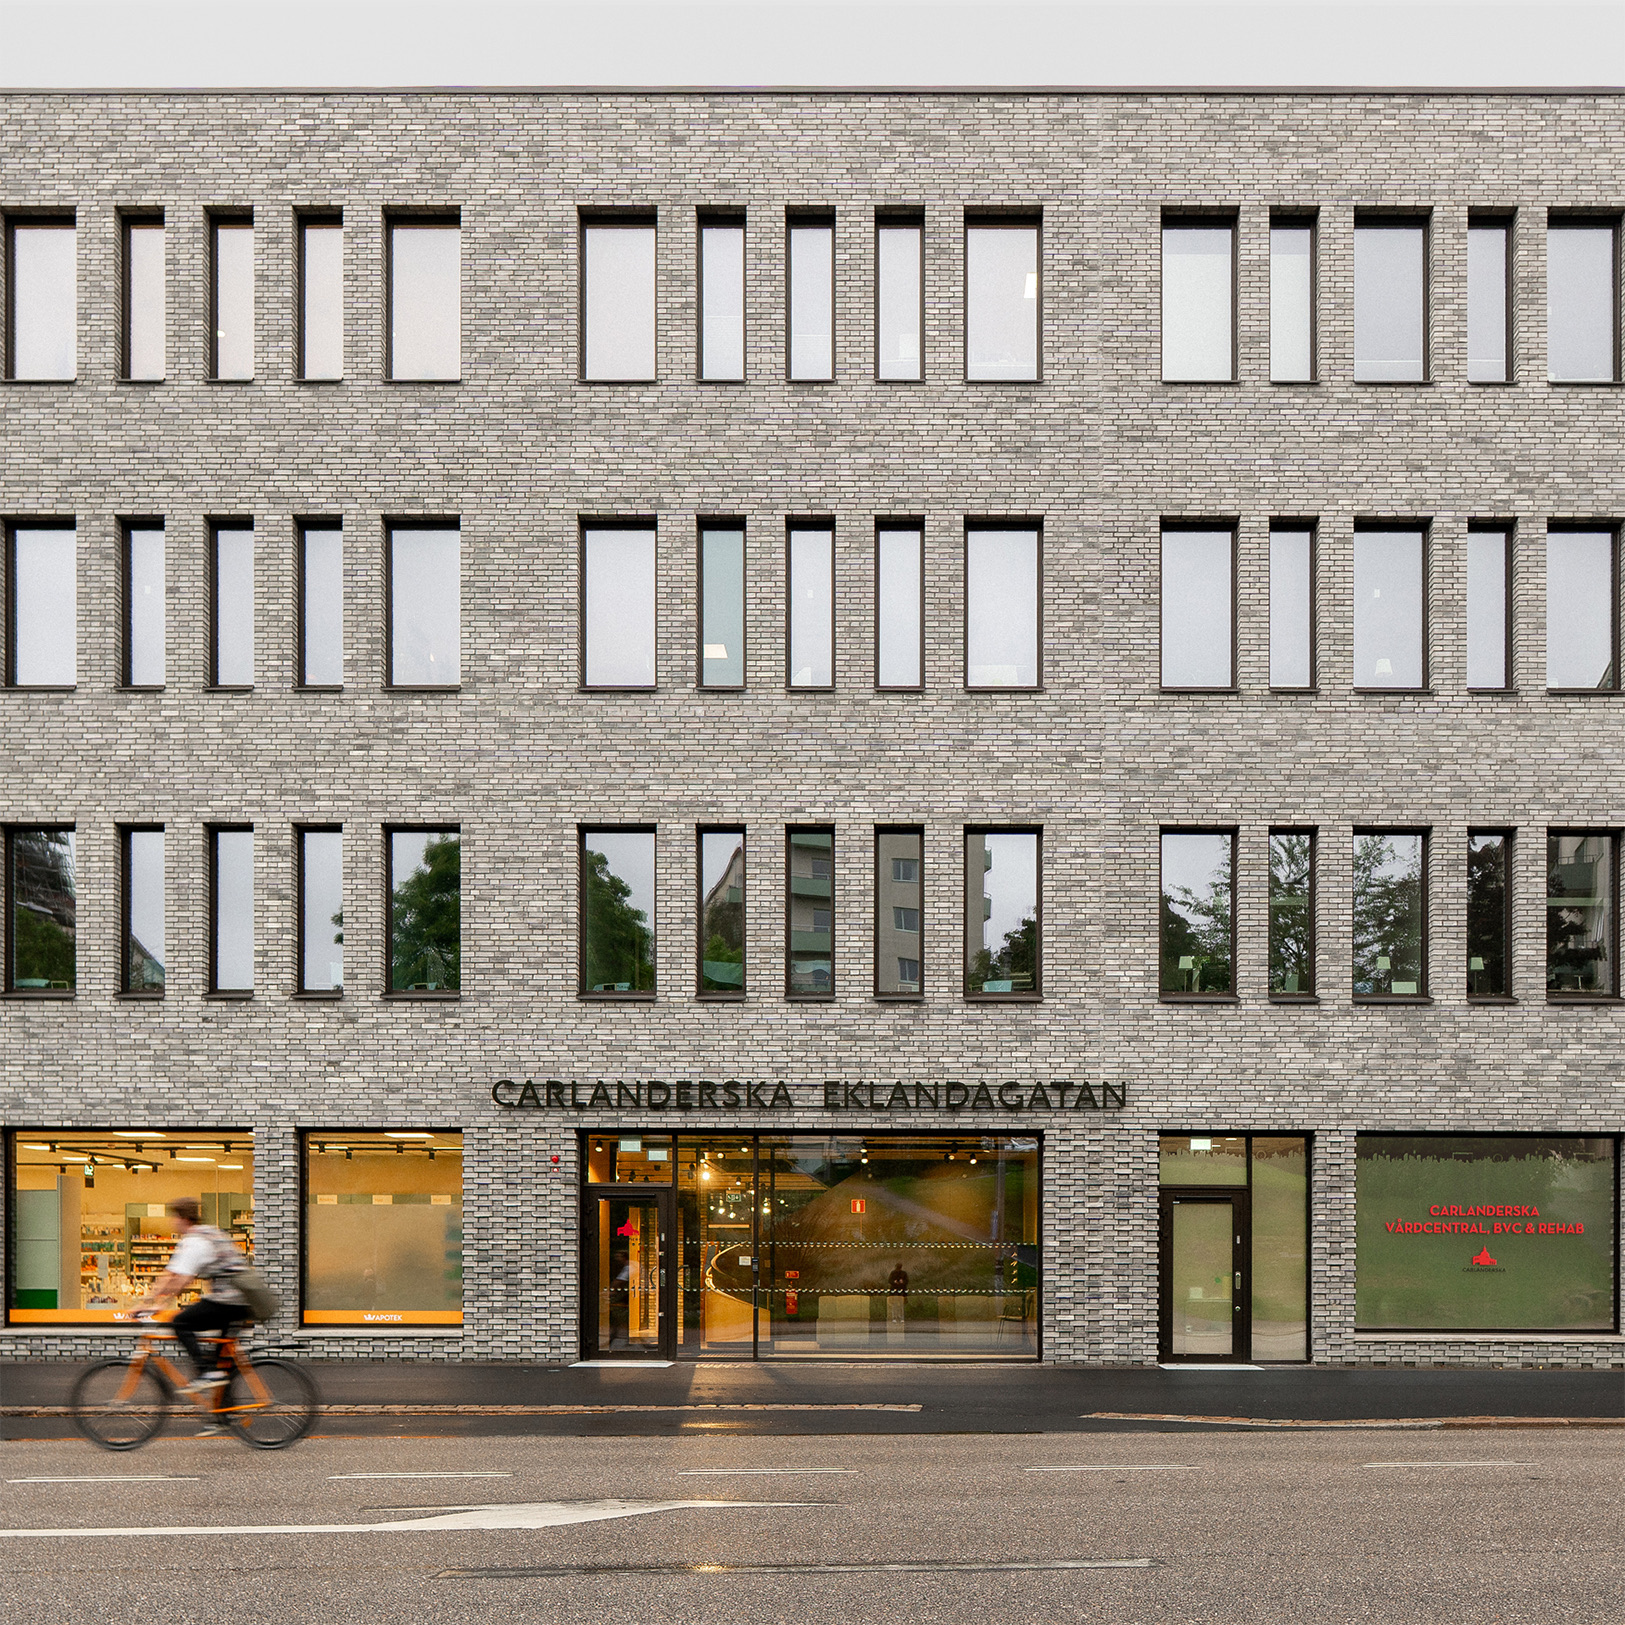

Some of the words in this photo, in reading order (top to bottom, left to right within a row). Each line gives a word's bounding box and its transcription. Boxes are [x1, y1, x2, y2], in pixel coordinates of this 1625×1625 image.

[491, 1079, 794, 1108] CARLANDERSKA
[823, 1080, 1127, 1109] EKLANDAGATAN
[1429, 1205, 1540, 1217] CARLANDERSKA
[1385, 1218, 1490, 1235] VÅRDCENTRAL,
[1493, 1222, 1522, 1234] BVC
[1525, 1222, 1535, 1234] &
[1538, 1222, 1584, 1234] REHAB
